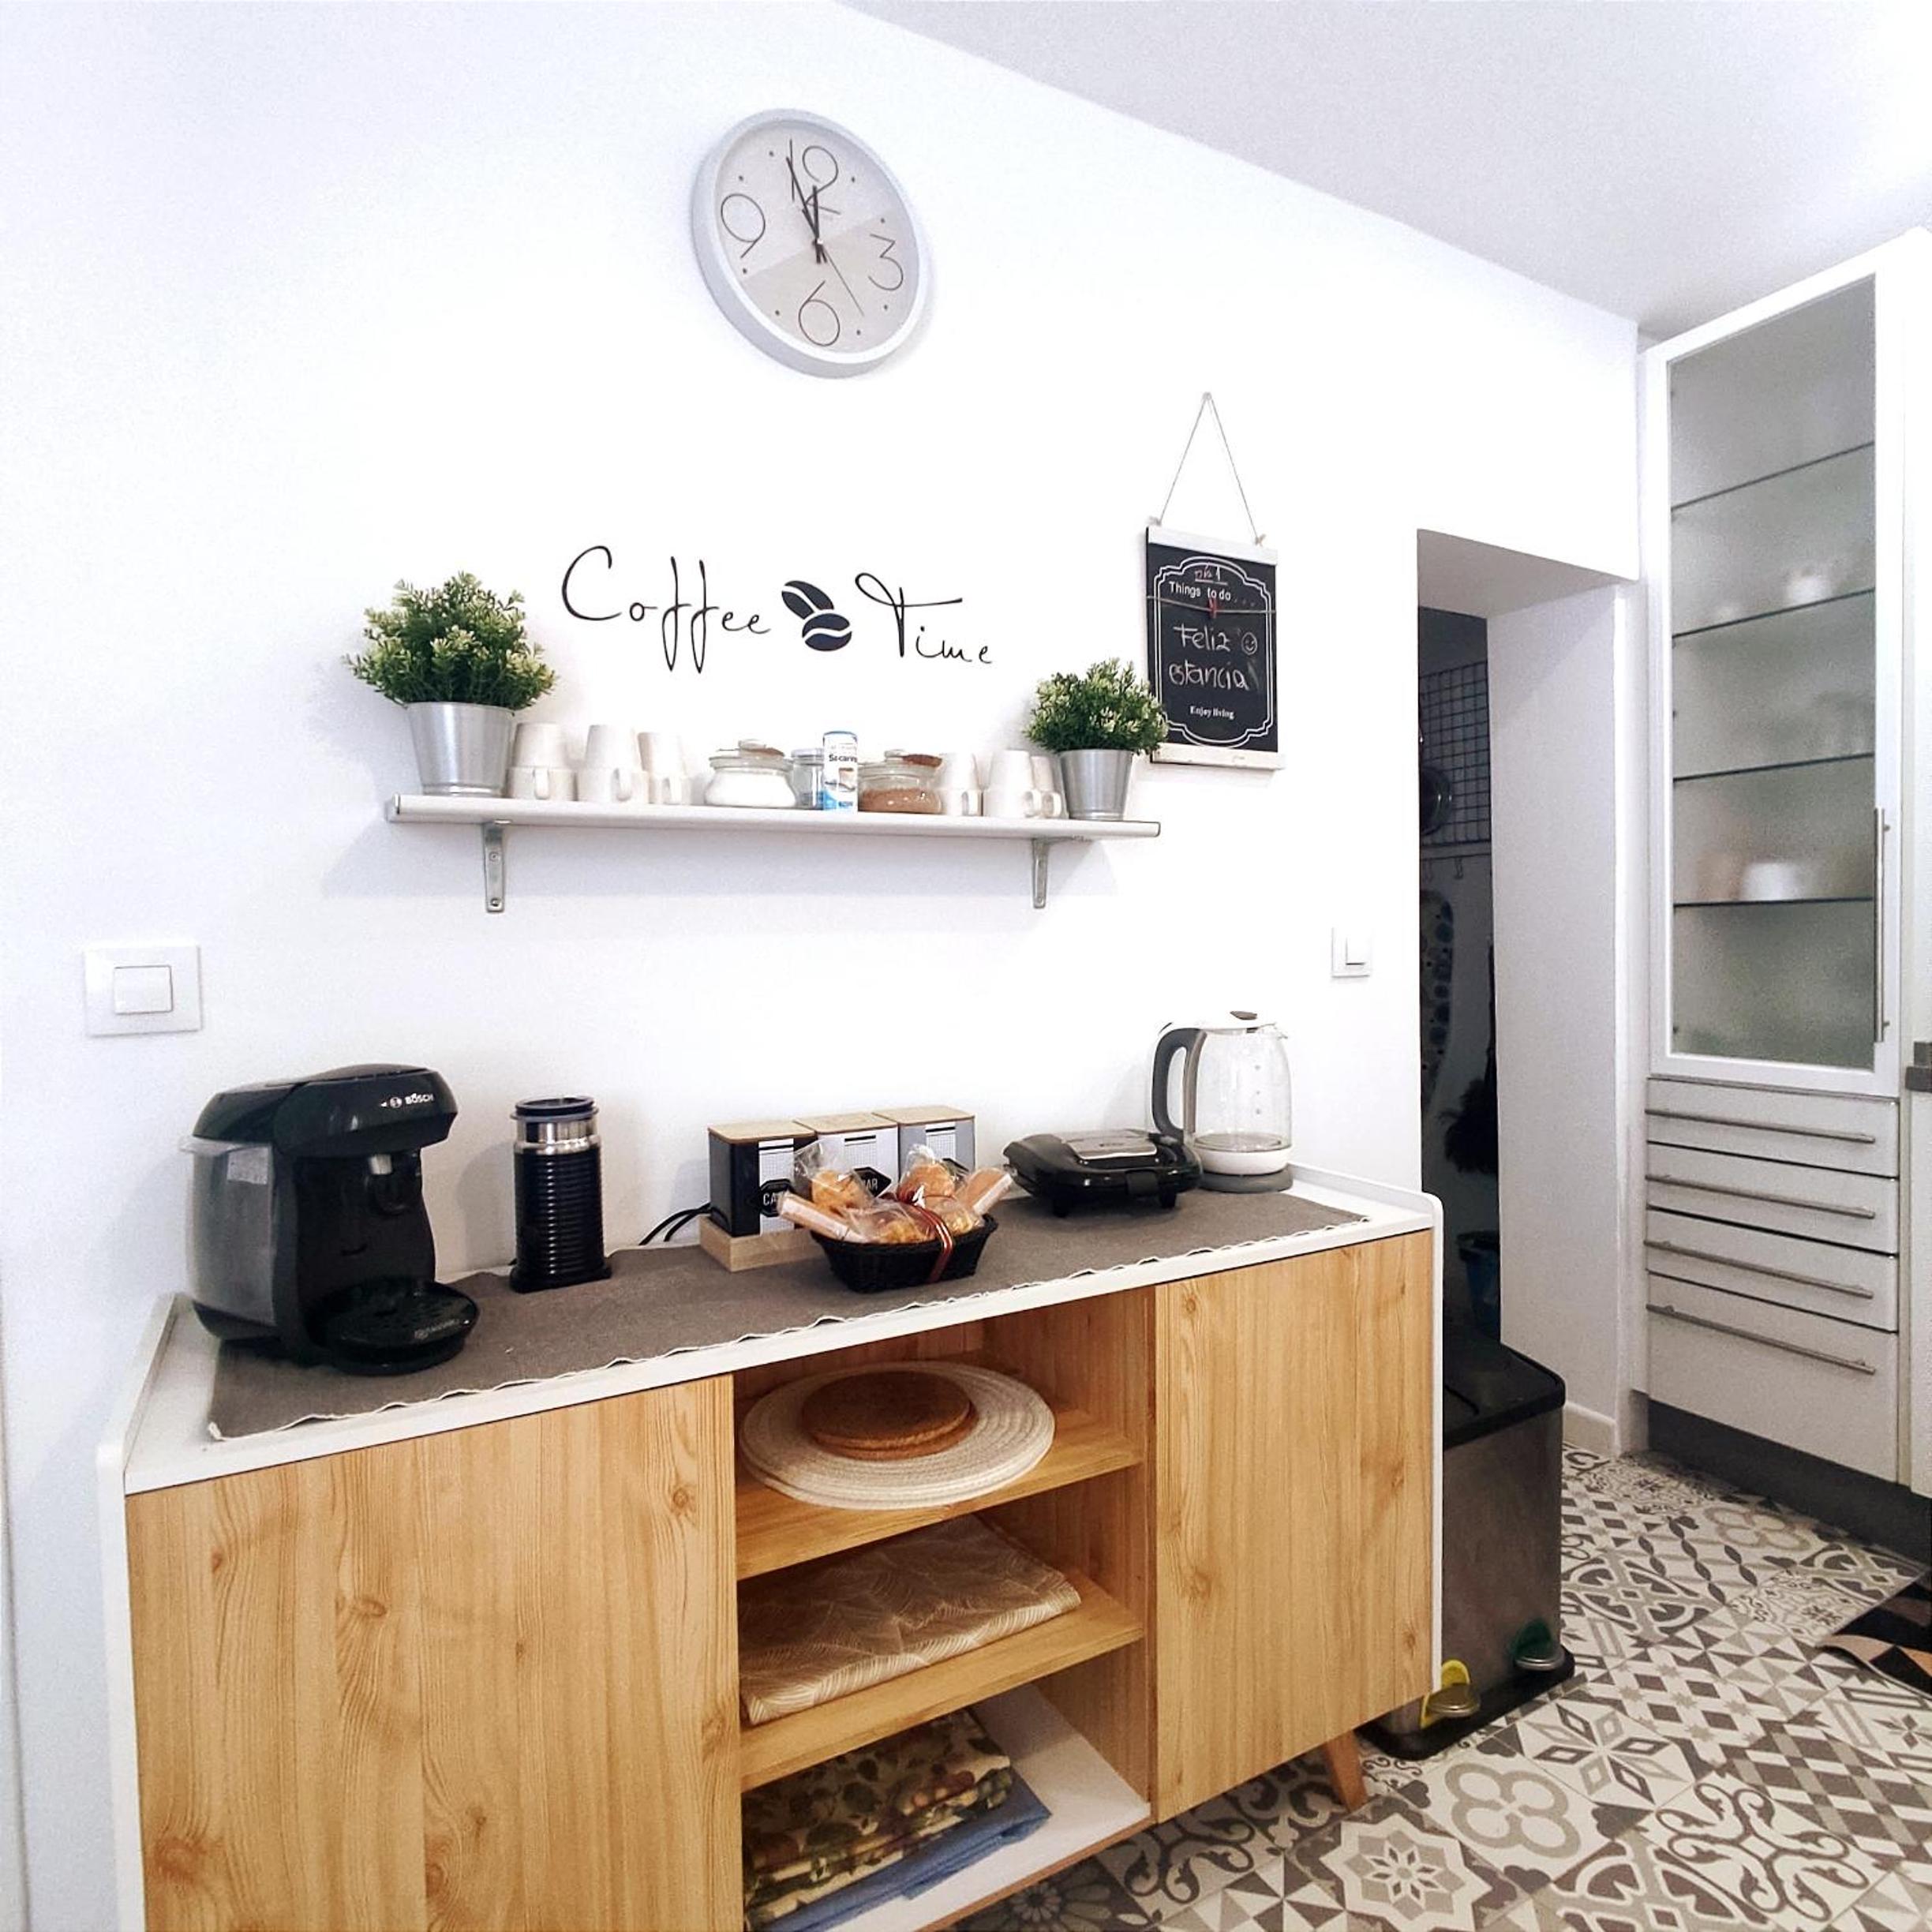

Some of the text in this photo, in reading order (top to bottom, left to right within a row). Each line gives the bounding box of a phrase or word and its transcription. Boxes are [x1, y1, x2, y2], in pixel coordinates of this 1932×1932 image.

[788, 138, 842, 215] 12
[721, 193, 766, 260] 9
[867, 233, 904, 291] 3
[798, 279, 841, 347] 6
[561, 545, 993, 674] Coffee Time
[1169, 581, 1201, 599] Things
[1207, 587, 1217, 599] to
[1173, 623, 1231, 652] Feliz
[1189, 706, 1235, 720] Enjoy living
[762, 1192, 777, 1206] CA
